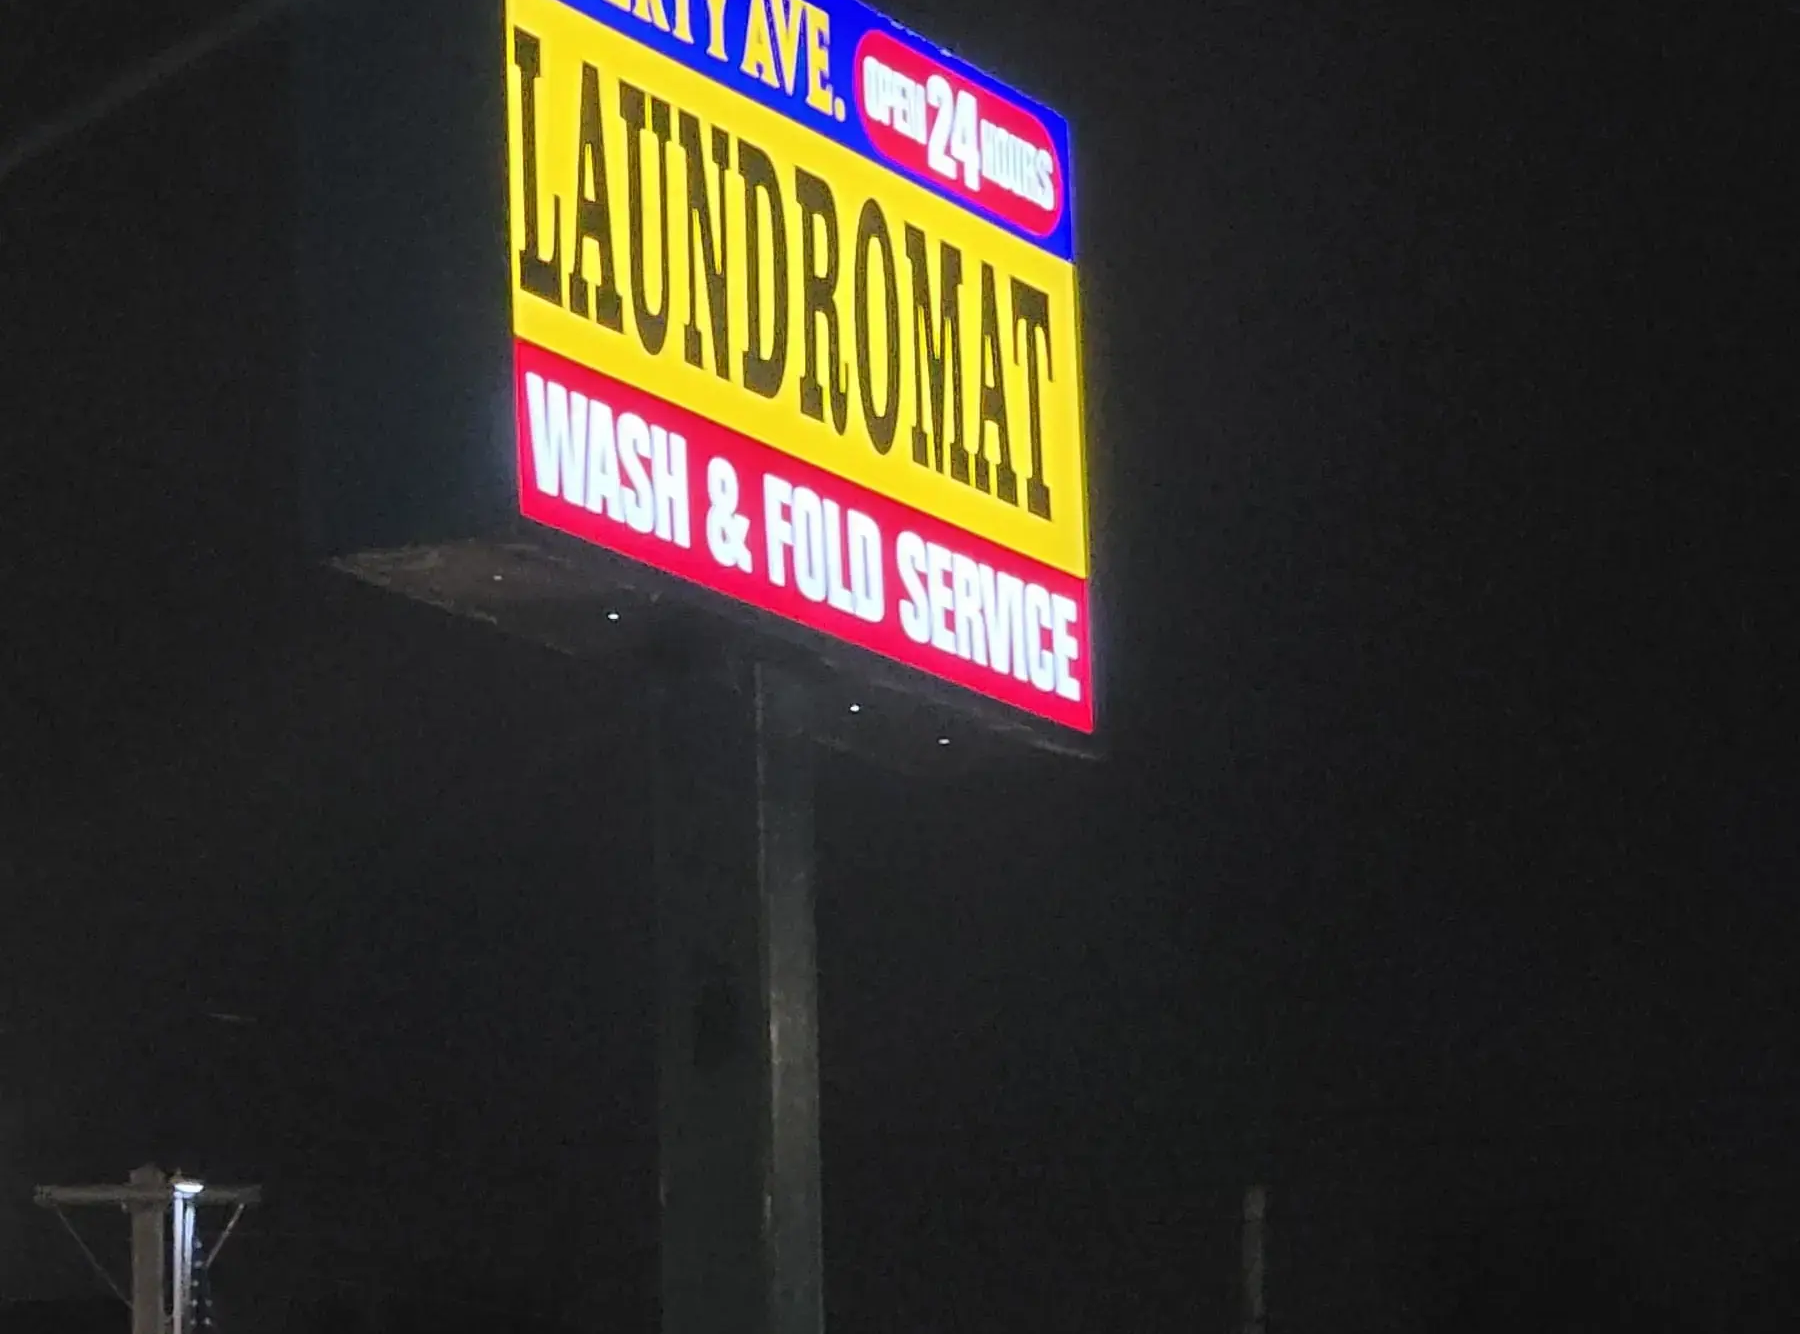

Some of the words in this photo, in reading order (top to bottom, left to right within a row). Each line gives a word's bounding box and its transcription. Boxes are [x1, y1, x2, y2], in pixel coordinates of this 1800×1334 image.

[514, 28, 1056, 521] LAUNDROMAT
[863, 56, 927, 145] OPEN
[926, 74, 980, 192] 24
[981, 118, 1054, 210] HOURS
[526, 371, 691, 548] WASH
[706, 457, 752, 574] &
[764, 472, 885, 623] FOLD
[898, 530, 1080, 701] SERVICE
